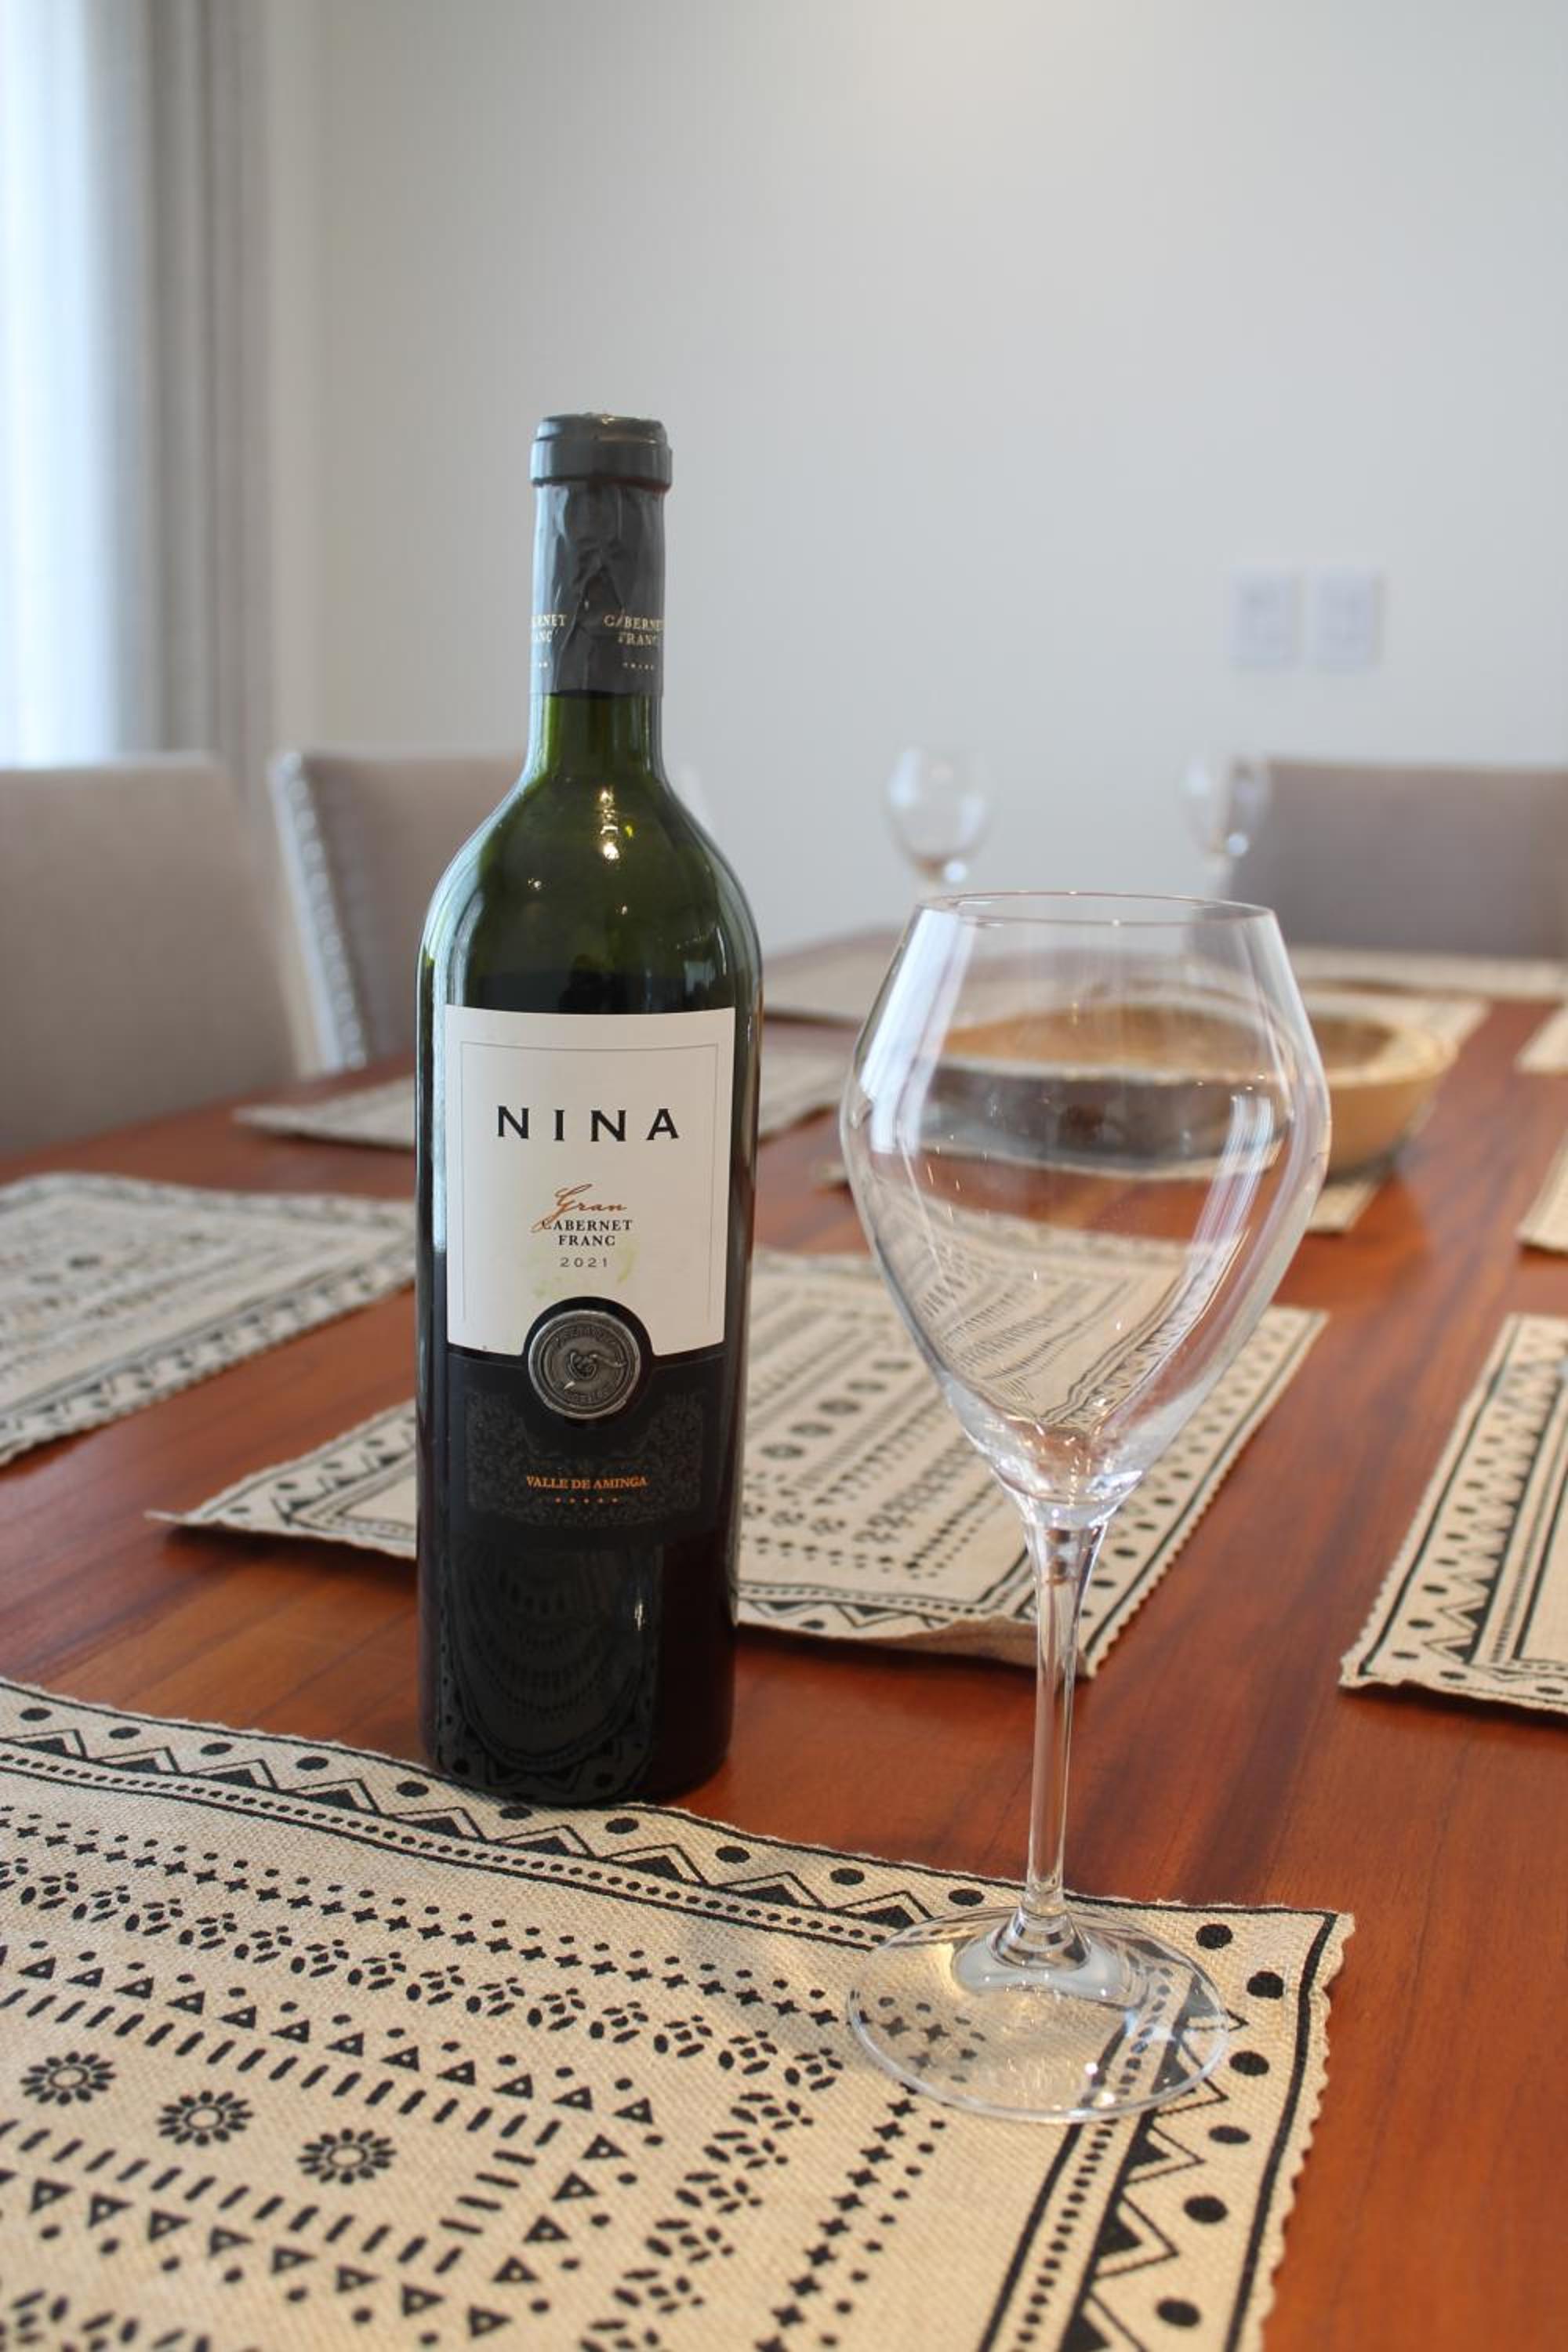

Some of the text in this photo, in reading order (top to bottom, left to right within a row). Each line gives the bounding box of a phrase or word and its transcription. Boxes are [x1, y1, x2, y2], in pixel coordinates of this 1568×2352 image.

[497, 1105, 680, 1142] NINA
[530, 1183, 628, 1233] Gran
[541, 1219, 633, 1232] CABERNET
[558, 1235, 615, 1247] FRANC
[560, 1257, 608, 1268] 2021
[526, 1475, 648, 1490] VALLE DE AMINGA
